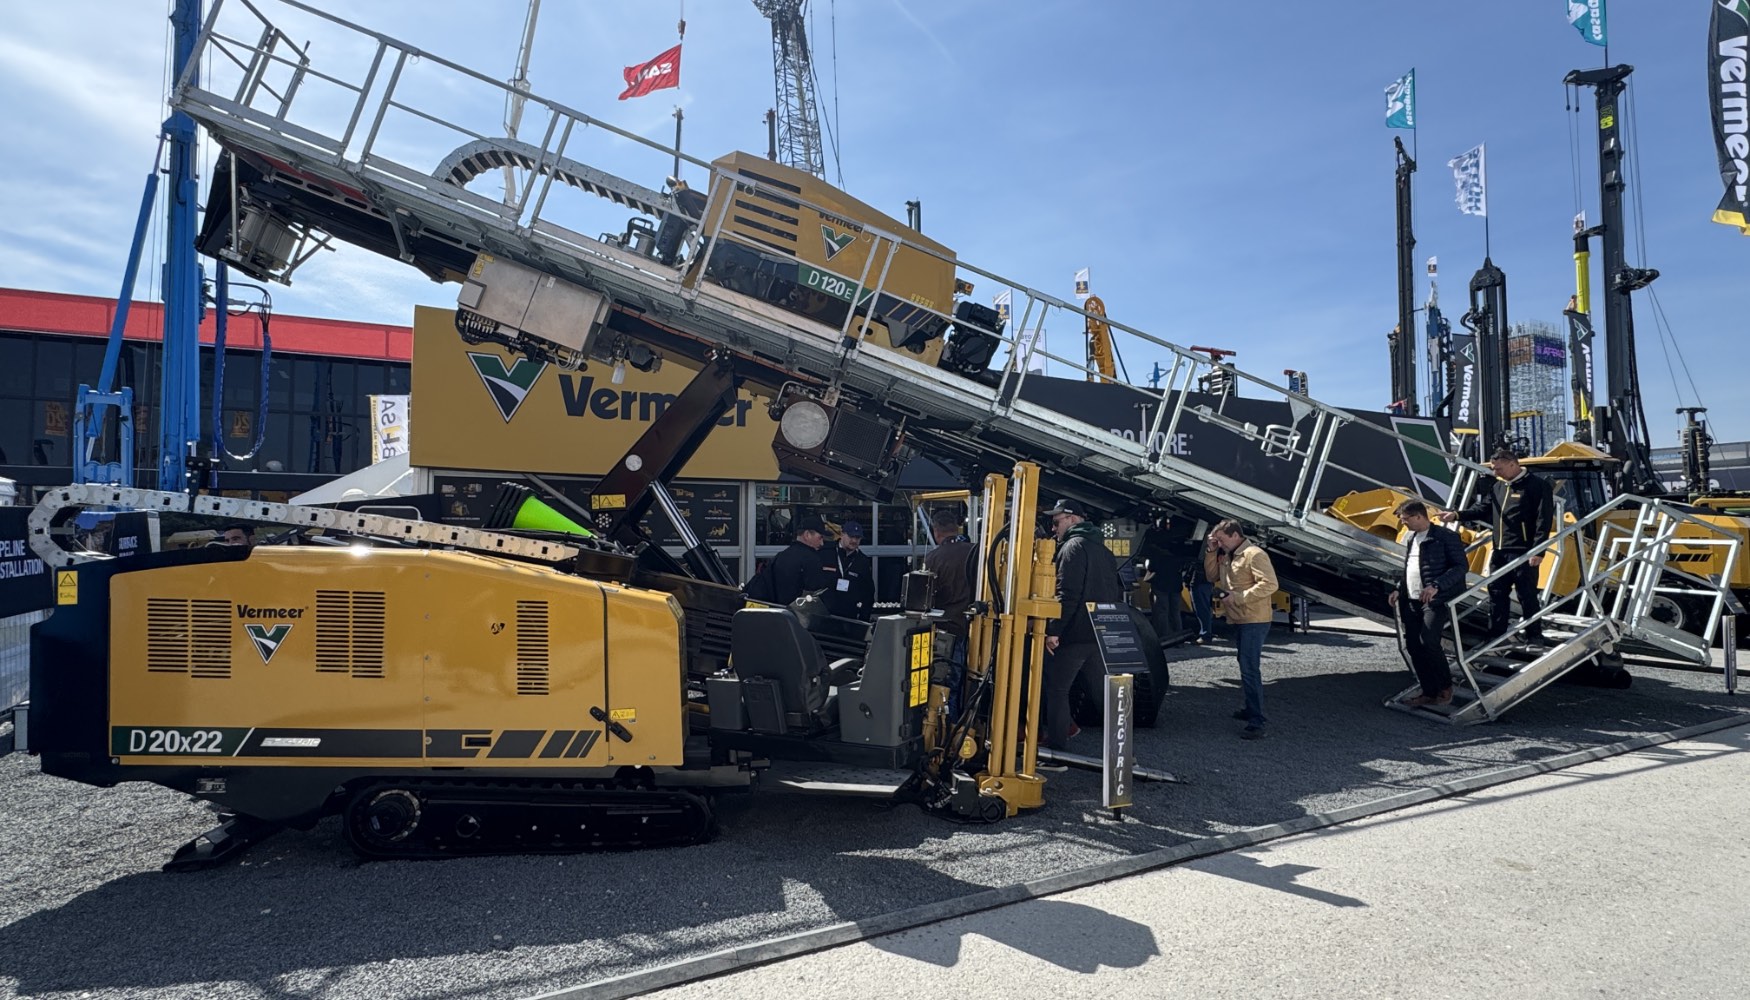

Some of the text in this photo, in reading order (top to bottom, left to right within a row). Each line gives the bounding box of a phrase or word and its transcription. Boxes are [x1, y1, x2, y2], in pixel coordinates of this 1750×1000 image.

[558, 373, 752, 428] Vermr
[1458, 364, 1473, 425] Vermeer
[237, 604, 304, 619] Vermeer
[1117, 686, 1125, 796] ELECTRIC
